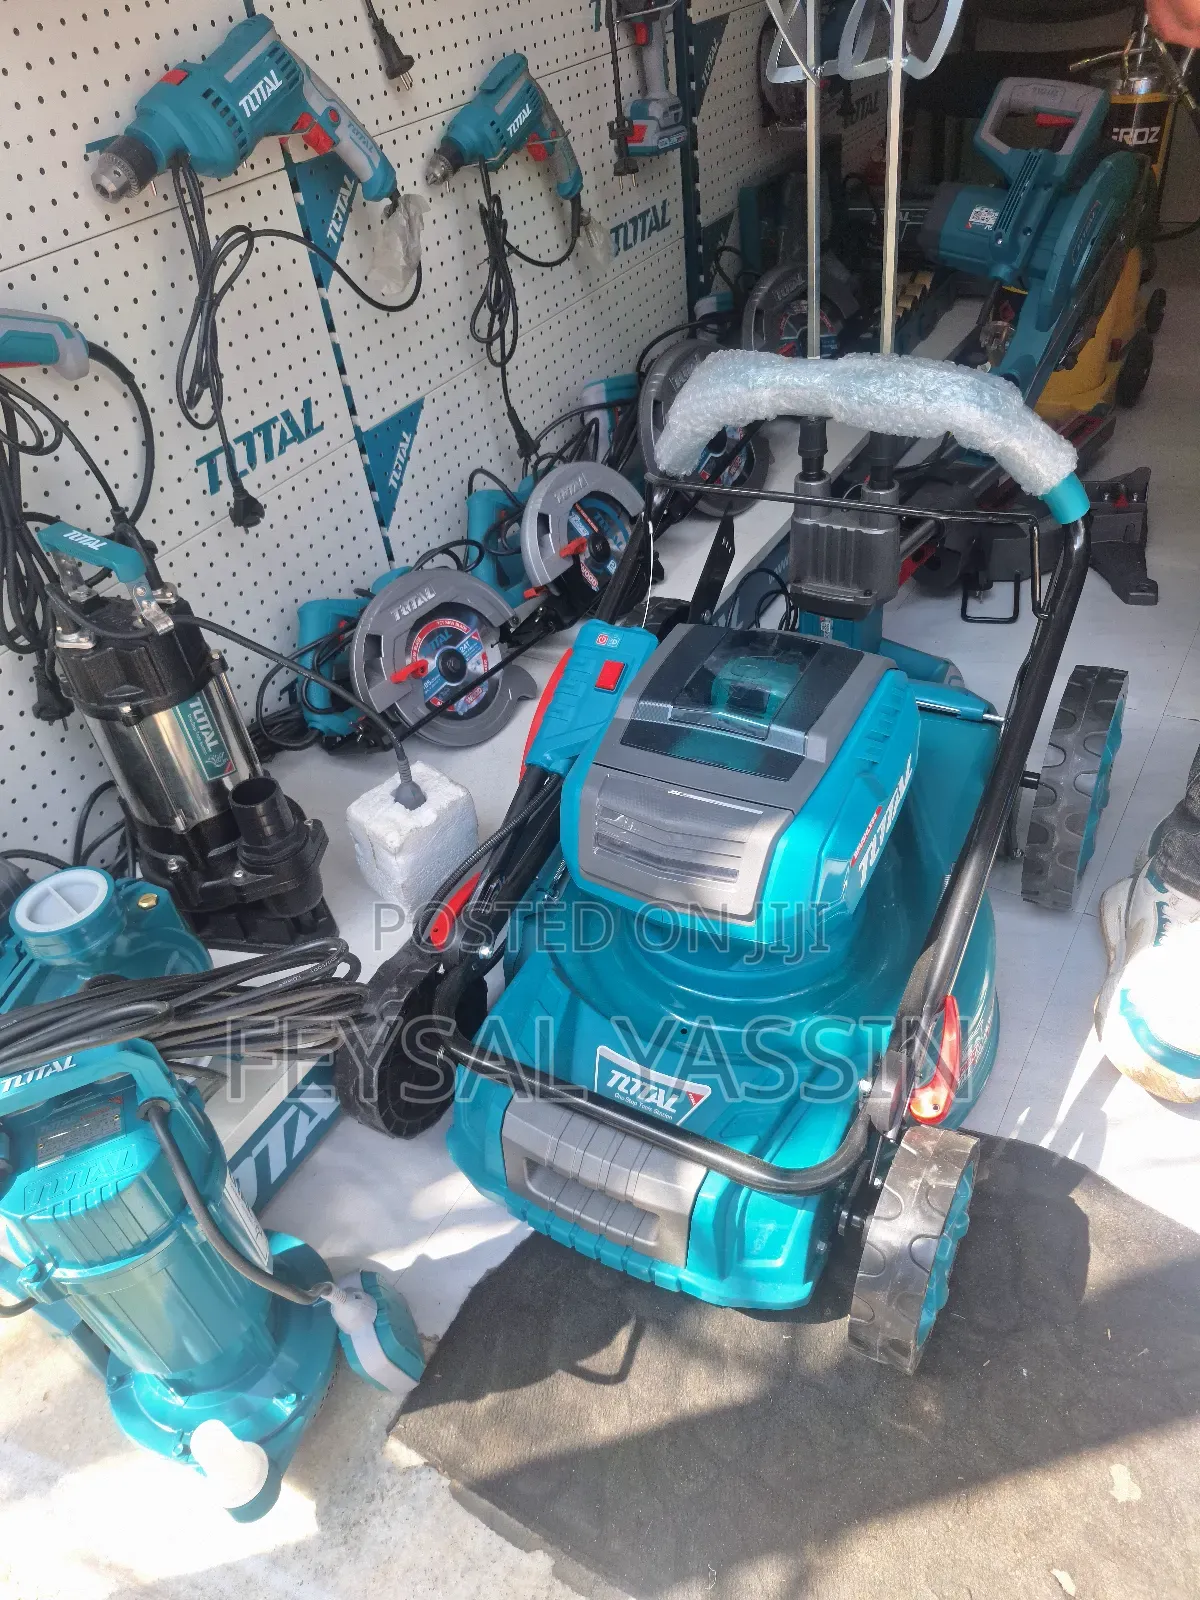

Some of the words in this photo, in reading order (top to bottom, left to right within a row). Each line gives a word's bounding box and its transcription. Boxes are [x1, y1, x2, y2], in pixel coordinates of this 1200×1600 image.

[239, 69, 283, 118] TOTAL
[505, 103, 533, 138] TOTAL
[326, 174, 356, 244] TOTAL
[609, 199, 671, 257] TOTAL
[195, 397, 324, 495] TOTAL
[388, 429, 414, 491] TOTAL
[63, 529, 108, 552] TOTAL
[390, 586, 437, 621] TOTAL
[188, 696, 221, 753] TOTAL
[858, 753, 913, 889] TOTAL
[0, 1055, 77, 1094] TOTAL
[607, 1070, 677, 1114] TOTAL
[625, 1096, 638, 1106] Stop
[24, 1147, 140, 1207] TOTAL
